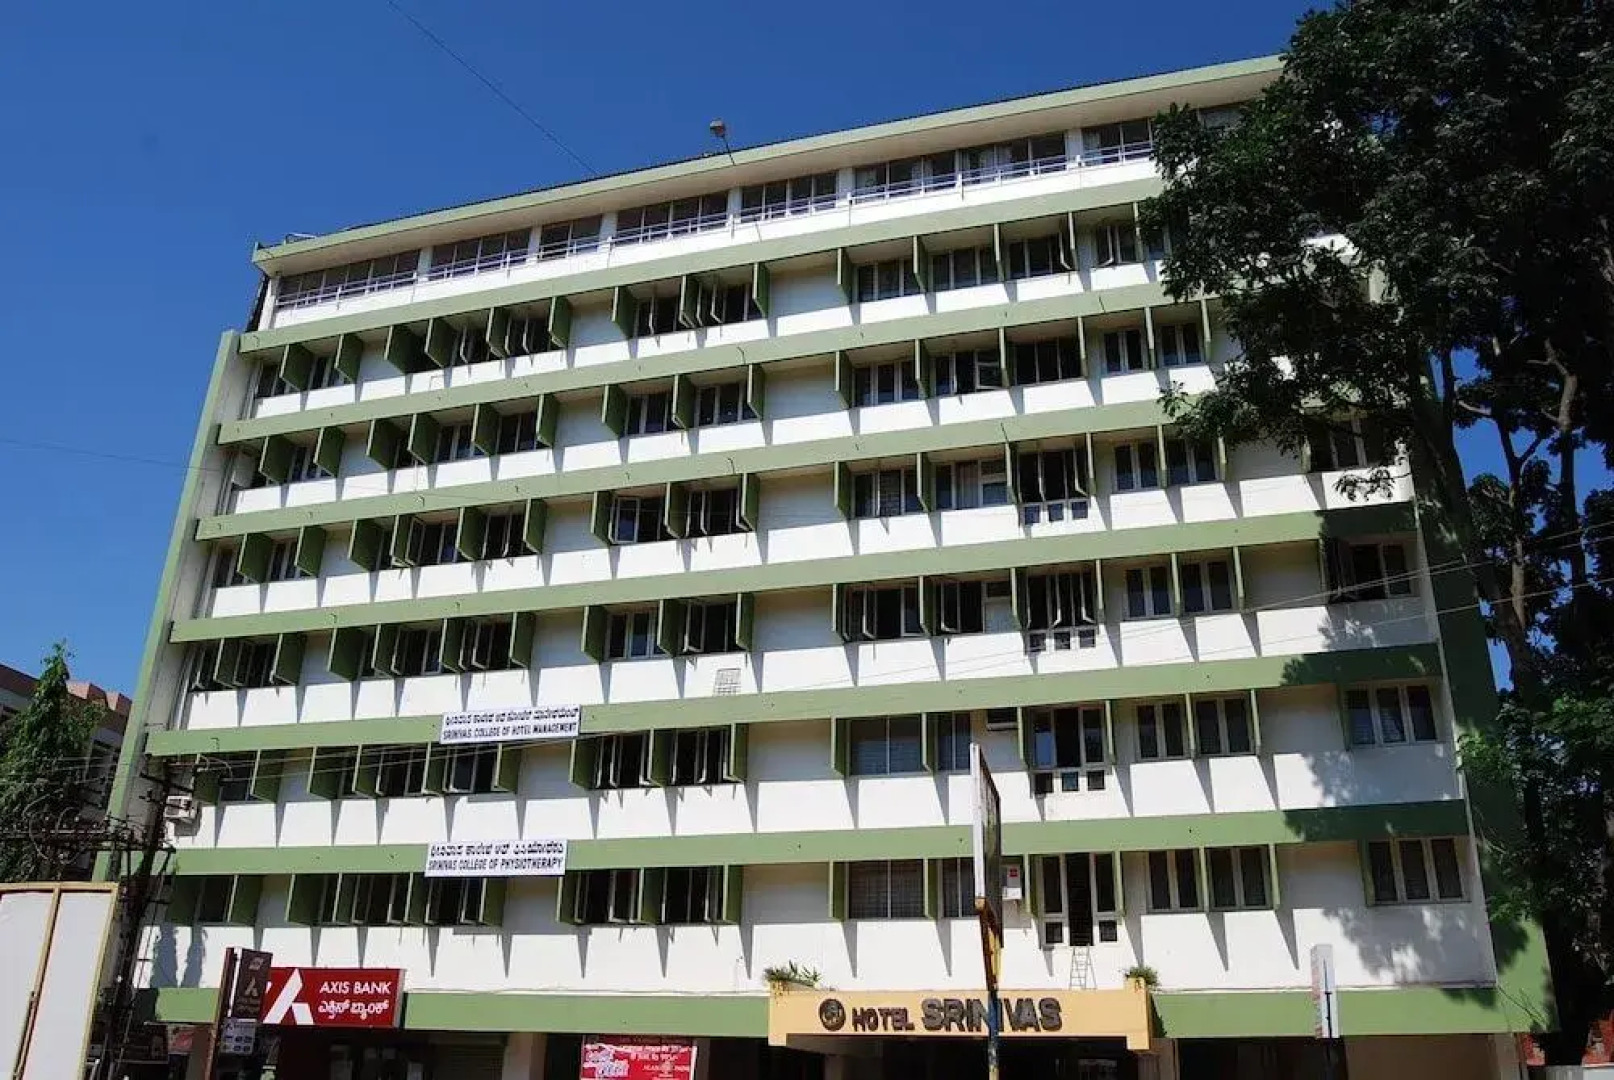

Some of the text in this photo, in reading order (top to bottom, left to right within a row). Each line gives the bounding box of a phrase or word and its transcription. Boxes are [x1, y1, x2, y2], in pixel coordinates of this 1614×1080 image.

[443, 722, 577, 740] SRINIVAS COLLEGE OF HOTEL MANAGEMENT
[428, 856, 563, 871] SRINIVAS COLLEGE OF PHYSIOTHERAPY
[319, 981, 392, 994] AXIS BANK
[851, 1007, 915, 1032] HOTEL
